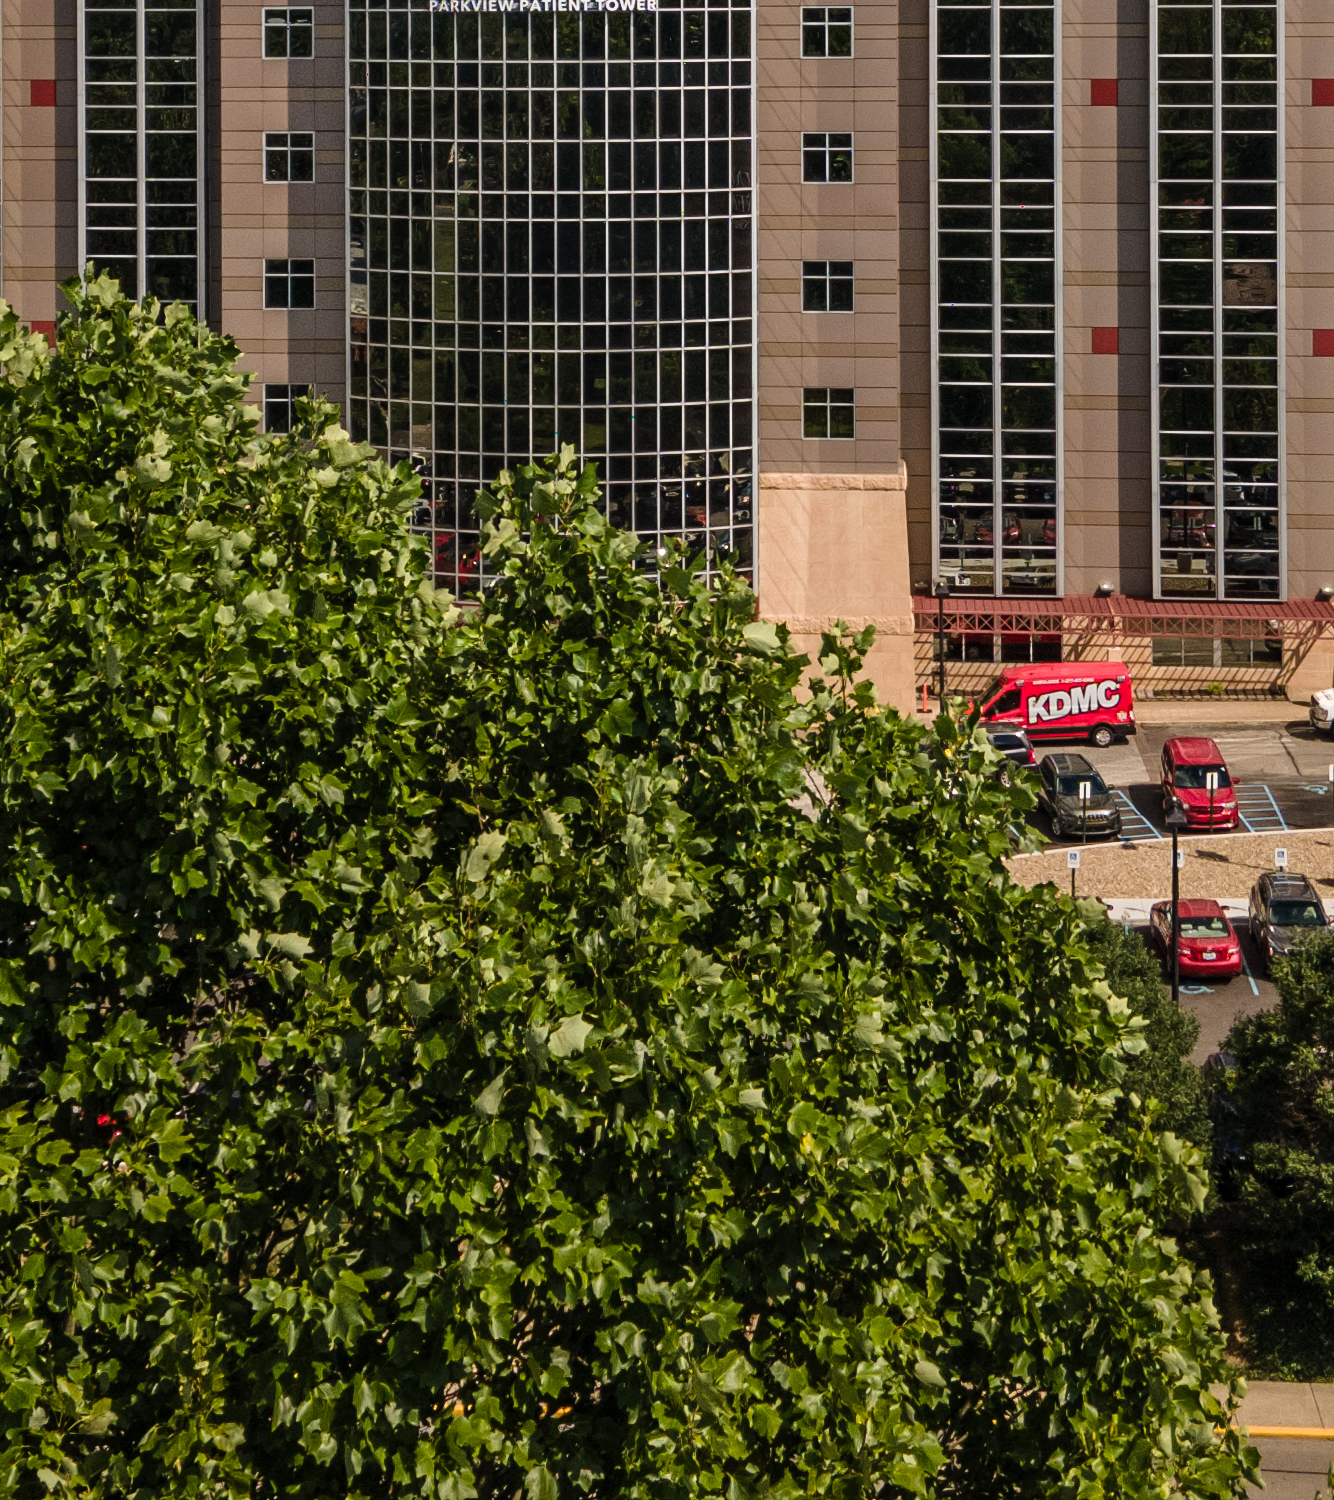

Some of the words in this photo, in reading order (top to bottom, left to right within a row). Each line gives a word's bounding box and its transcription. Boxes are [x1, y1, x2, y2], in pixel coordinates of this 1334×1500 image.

[429, 0, 514, 12] PARKVIEW
[519, 0, 590, 11] PATIENT
[1028, 679, 1120, 725] KDMC
